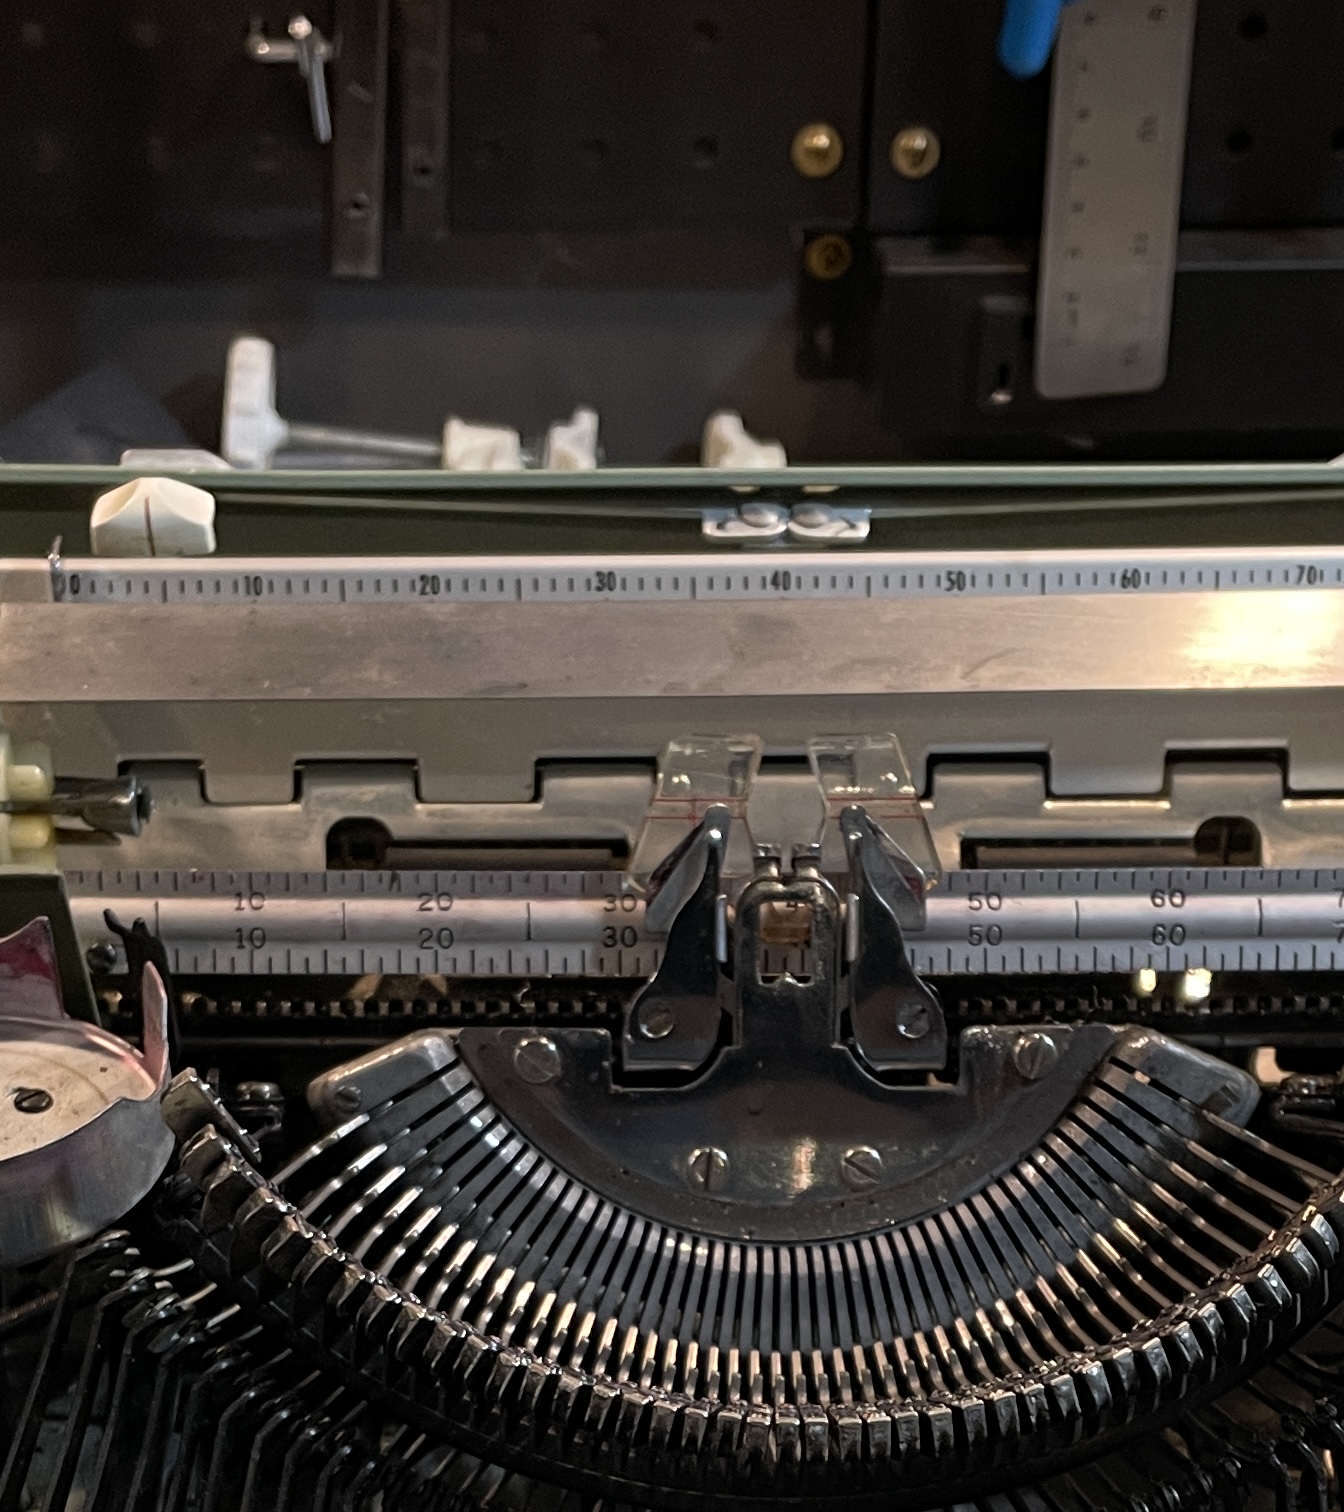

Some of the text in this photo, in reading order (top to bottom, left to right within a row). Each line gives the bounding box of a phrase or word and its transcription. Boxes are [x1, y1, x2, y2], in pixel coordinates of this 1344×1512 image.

[244, 575, 263, 596] 10
[420, 574, 440, 596] 20
[595, 571, 616, 592] 30
[771, 570, 791, 592] 40
[944, 571, 966, 592] 50
[1121, 569, 1142, 590] 60
[1295, 565, 1318, 587] 70
[234, 891, 265, 913] 10
[417, 891, 455, 913] 20
[602, 893, 638, 912] 30
[967, 890, 1003, 912] 50
[1150, 888, 1187, 909] 60
[234, 926, 266, 950] 10
[417, 927, 455, 951] 20
[602, 926, 638, 949] 30
[967, 924, 1003, 947] 50
[1150, 923, 1187, 946] 60
